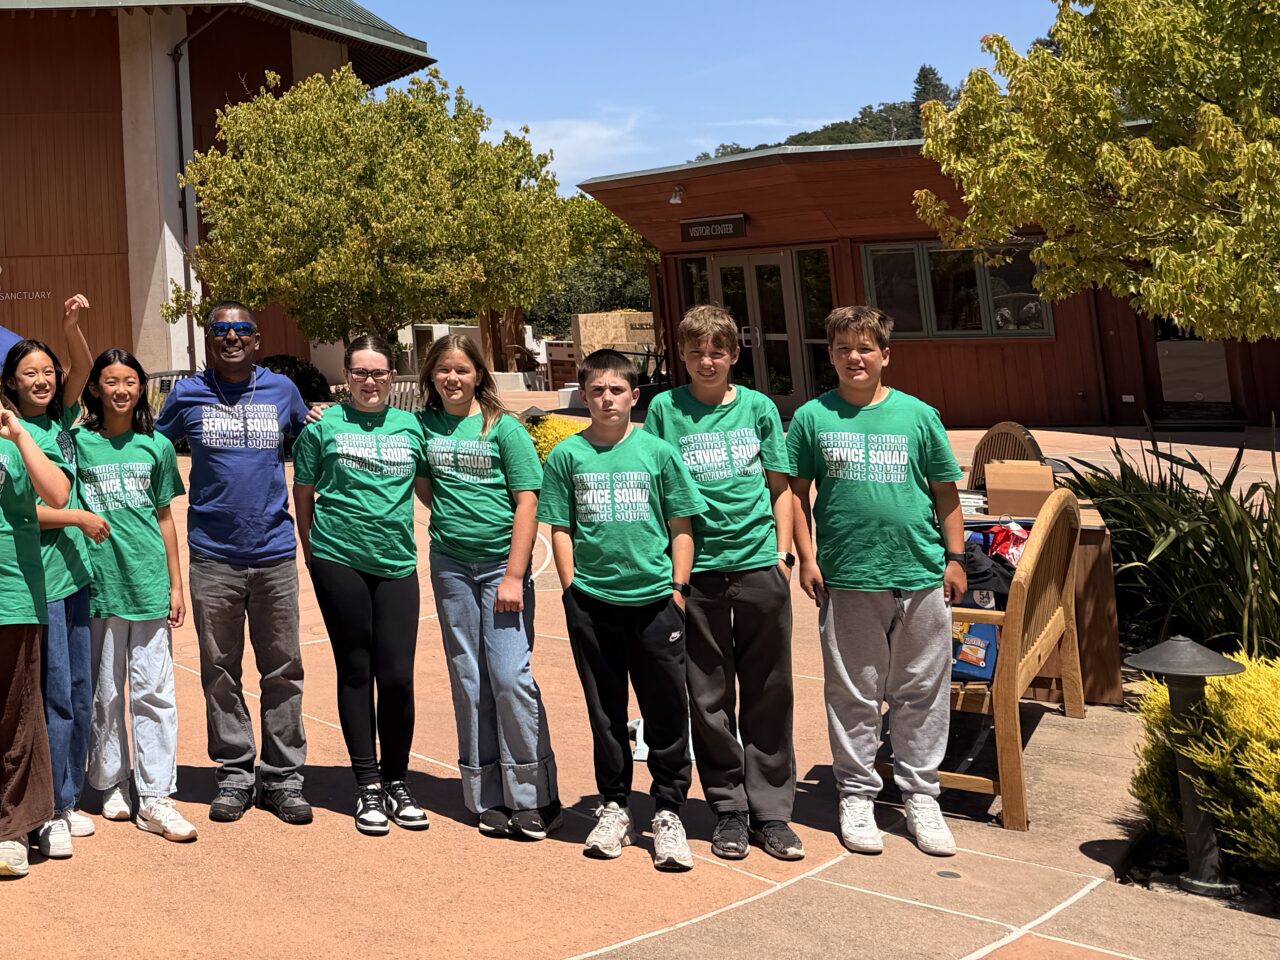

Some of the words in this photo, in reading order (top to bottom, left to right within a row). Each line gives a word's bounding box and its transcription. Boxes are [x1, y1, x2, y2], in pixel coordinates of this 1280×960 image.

[689, 226, 710, 237] VISITOR
[711, 223, 734, 235] CENTER
[0, 291, 51, 300] SANCTUARY
[202, 418, 244, 431] SERVICE
[247, 418, 279, 432] SQUAD
[458, 453, 492, 469] SQUAD
[682, 448, 729, 466] SERVICE
[822, 447, 865, 462] SERVICE
[869, 450, 908, 465] SQUAD
[84, 479, 122, 496] SERVICE
[614, 488, 649, 503] SQUAD
[979, 591, 990, 601] 54
